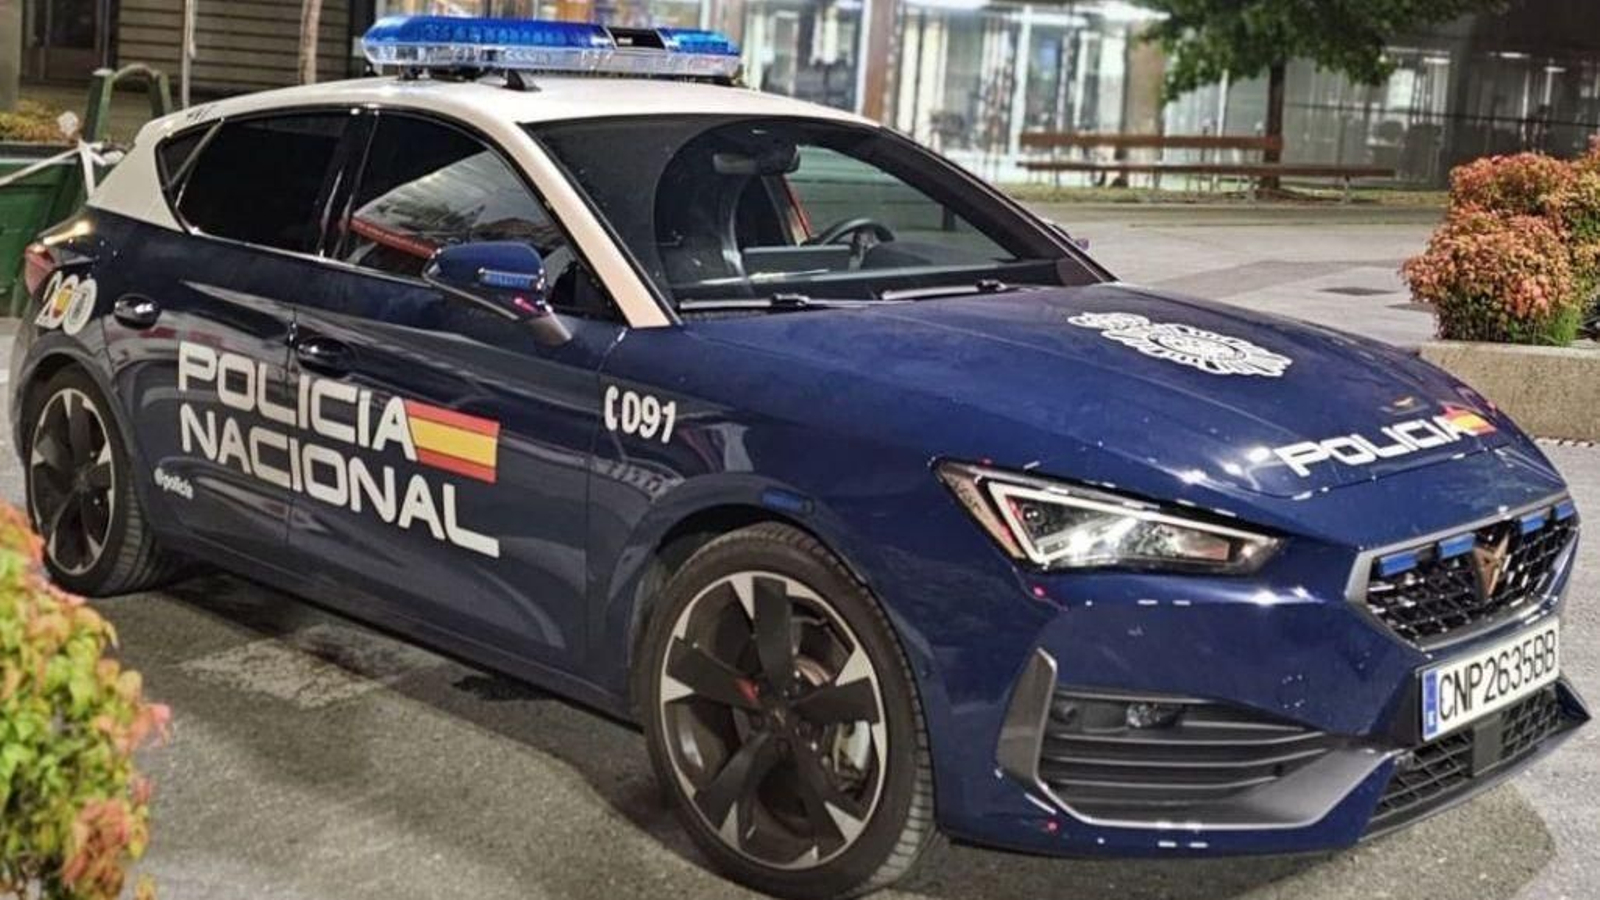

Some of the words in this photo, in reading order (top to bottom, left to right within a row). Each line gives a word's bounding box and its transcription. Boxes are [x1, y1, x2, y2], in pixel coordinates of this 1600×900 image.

[178, 341, 418, 462] POLICIA
[621, 391, 676, 444] 091
[1273, 415, 1479, 477] POLICIA
[179, 403, 500, 558] NACIONAL
